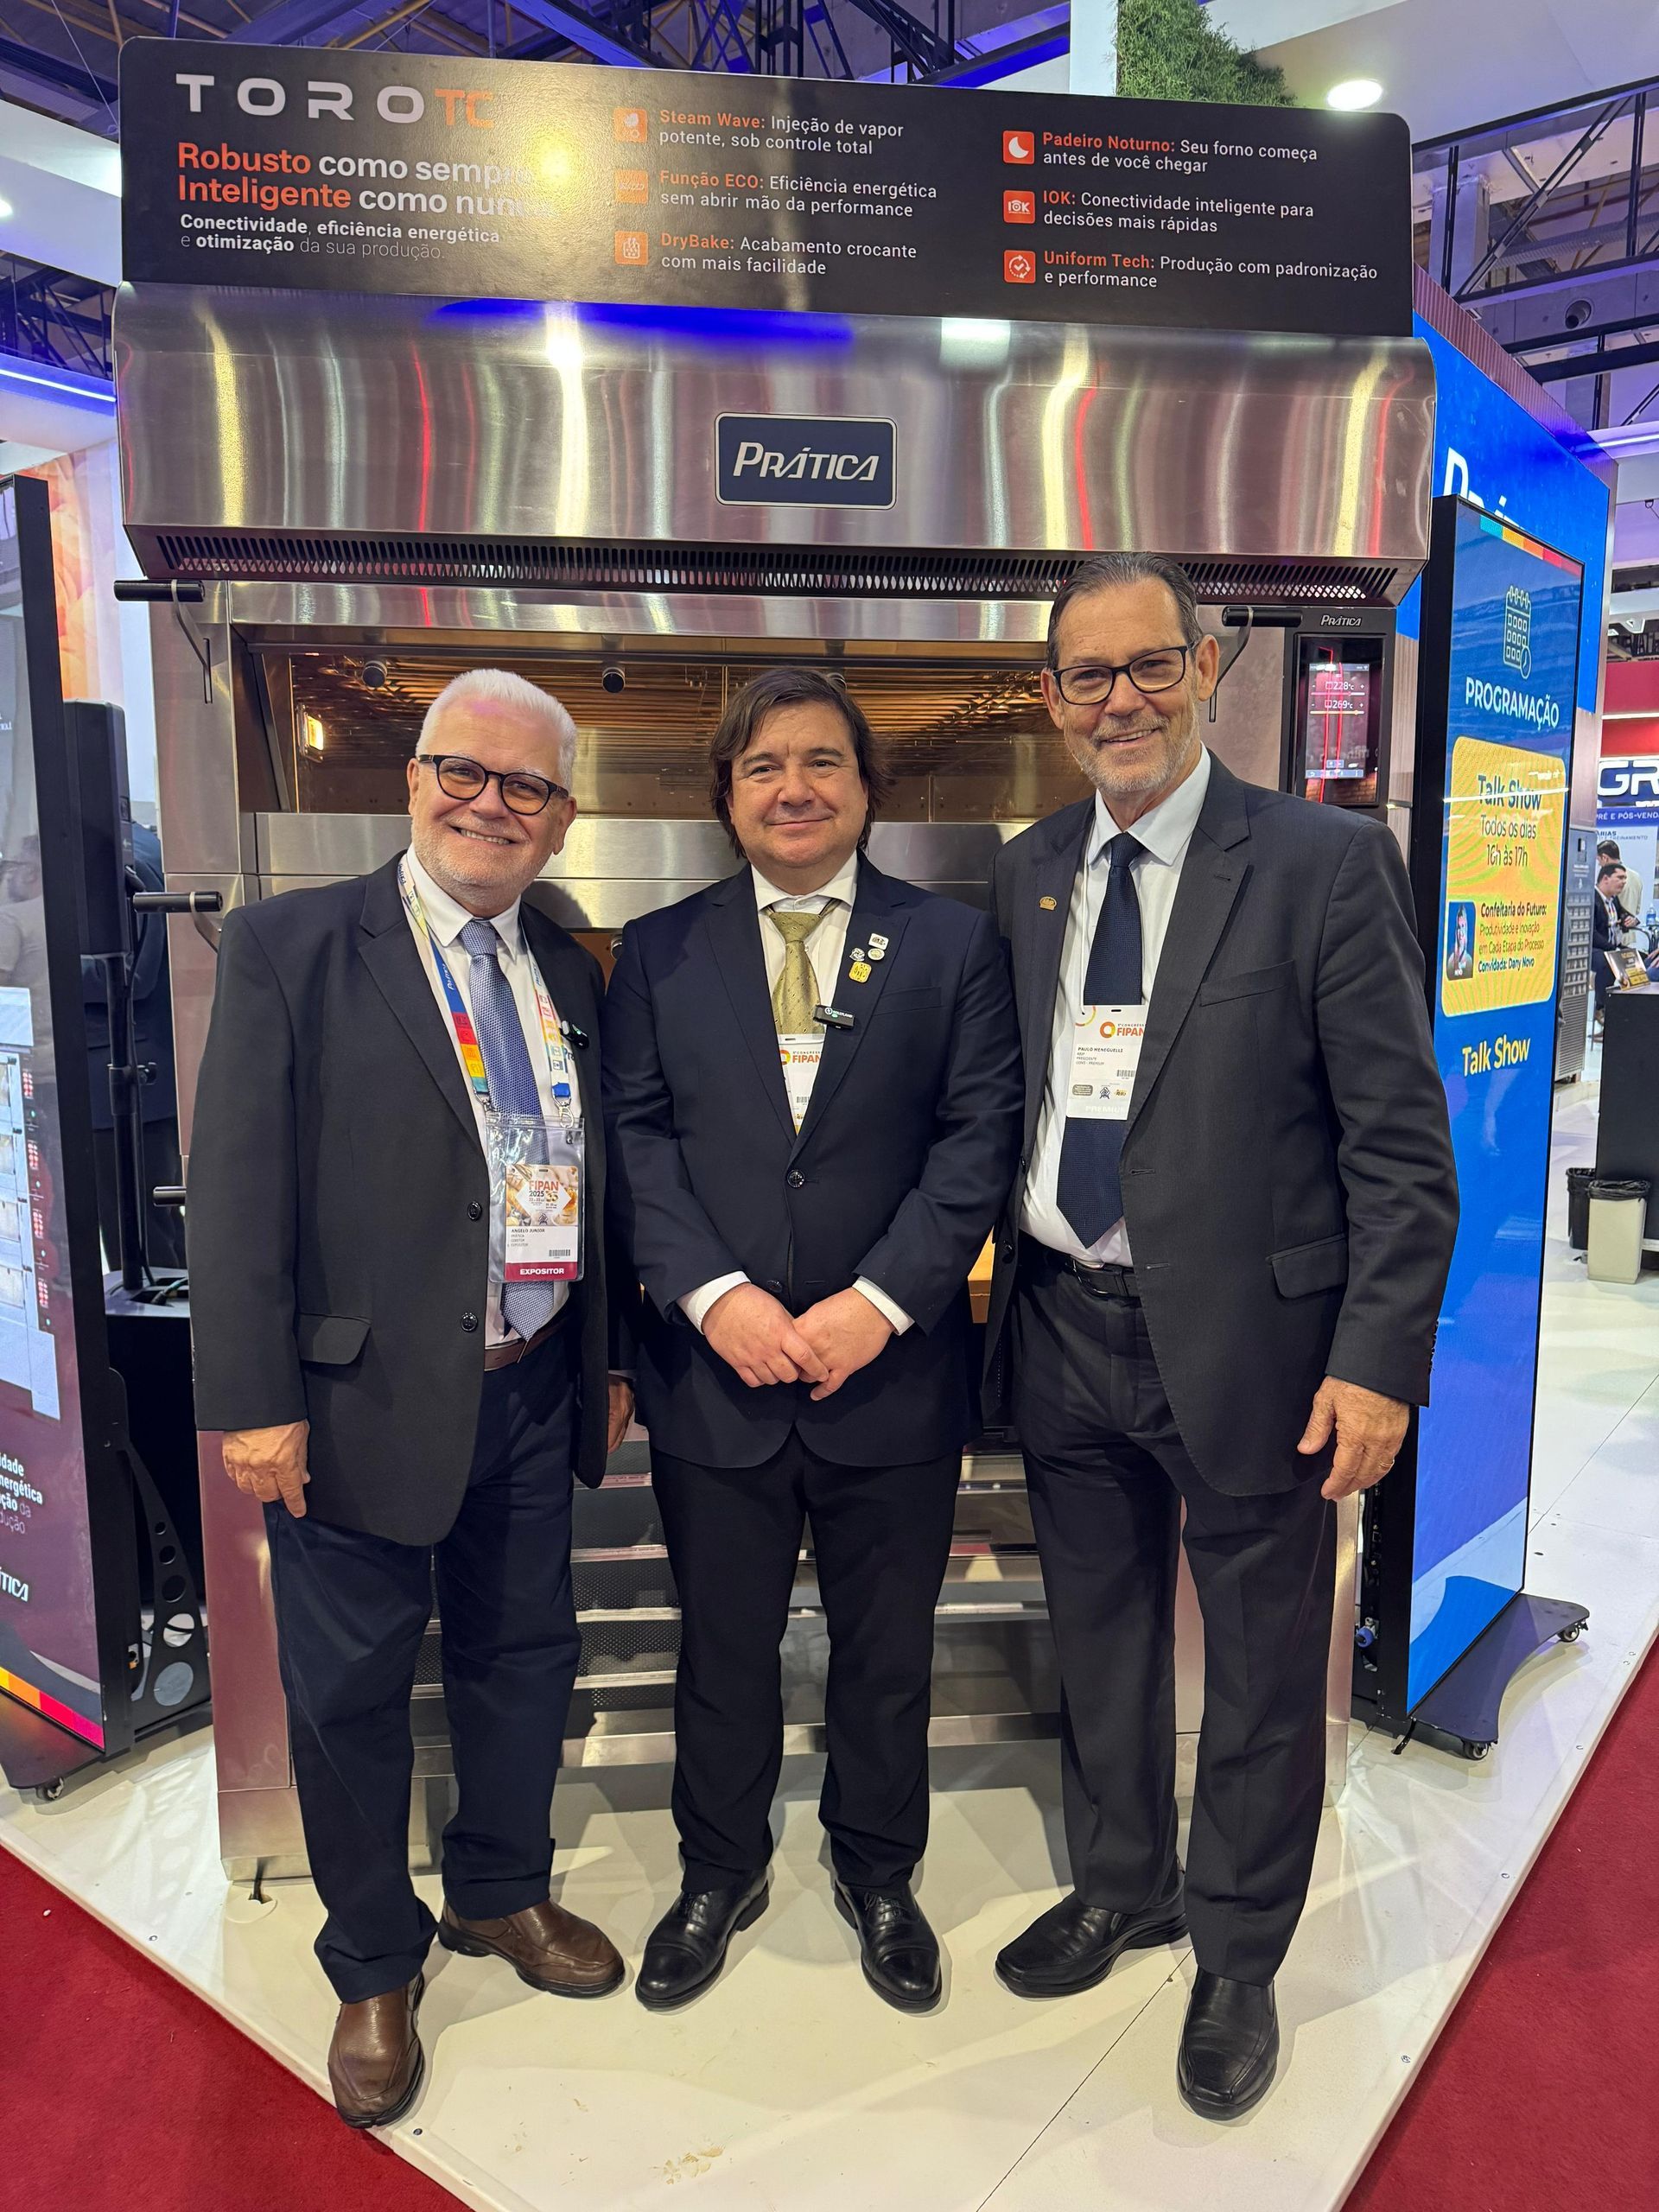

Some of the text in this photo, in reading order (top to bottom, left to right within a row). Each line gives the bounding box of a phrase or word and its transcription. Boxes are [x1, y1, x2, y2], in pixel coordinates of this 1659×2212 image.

[175, 73, 494, 129] TORO TC
[659, 109, 904, 139] Steam Wave: Injeção de vapor
[659, 132, 873, 155] potente, sob controle total
[1042, 132, 1318, 162] Padeiro Noturno: Seu forno começa
[177, 142, 311, 175] Robusto
[318, 155, 408, 180] como
[1043, 152, 1208, 175] antes de você chegar
[178, 175, 351, 211] Inteligente
[359, 191, 448, 213] como
[659, 170, 719, 188] Função
[725, 174, 764, 189] ECO:
[769, 175, 848, 194] Eficiência
[853, 181, 937, 200] energética
[660, 193, 913, 218] sem abrir mão da performance
[1043, 190, 1314, 219] IOK: Conectividade inteligente para
[180, 213, 500, 245] Conectividade, eficiência energética
[1043, 210, 1217, 235] decisões mais rápidas
[180, 234, 446, 261] e otimização da sua produção.
[660, 232, 917, 258] DryBake: Acabamento crocante
[661, 256, 826, 275] com mais facilidade
[1044, 251, 1378, 280] Uniform Tech: Produção com padronização
[1045, 270, 1157, 289] e performance
[1465, 677, 1559, 730] PROGRAMAÇÃO
[1478, 775, 1541, 810] Talk Show
[1480, 815, 1536, 839] Todos os dias
[1596, 811, 1607, 820] RÉ
[1618, 811, 1659, 820] PÓS-VEND
[1487, 844, 1502, 866] 16h
[1515, 846, 1529, 867] 17h
[1481, 900, 1516, 918] Confeitaria
[1516, 900, 1525, 917] do
[1489, 941, 1502, 954] Cada
[1522, 957, 1535, 968] Novo
[1462, 1034, 1530, 1077] Talk Show
[529, 1180, 559, 1191] FIPAN
[0, 1492, 31, 1518] ção da
